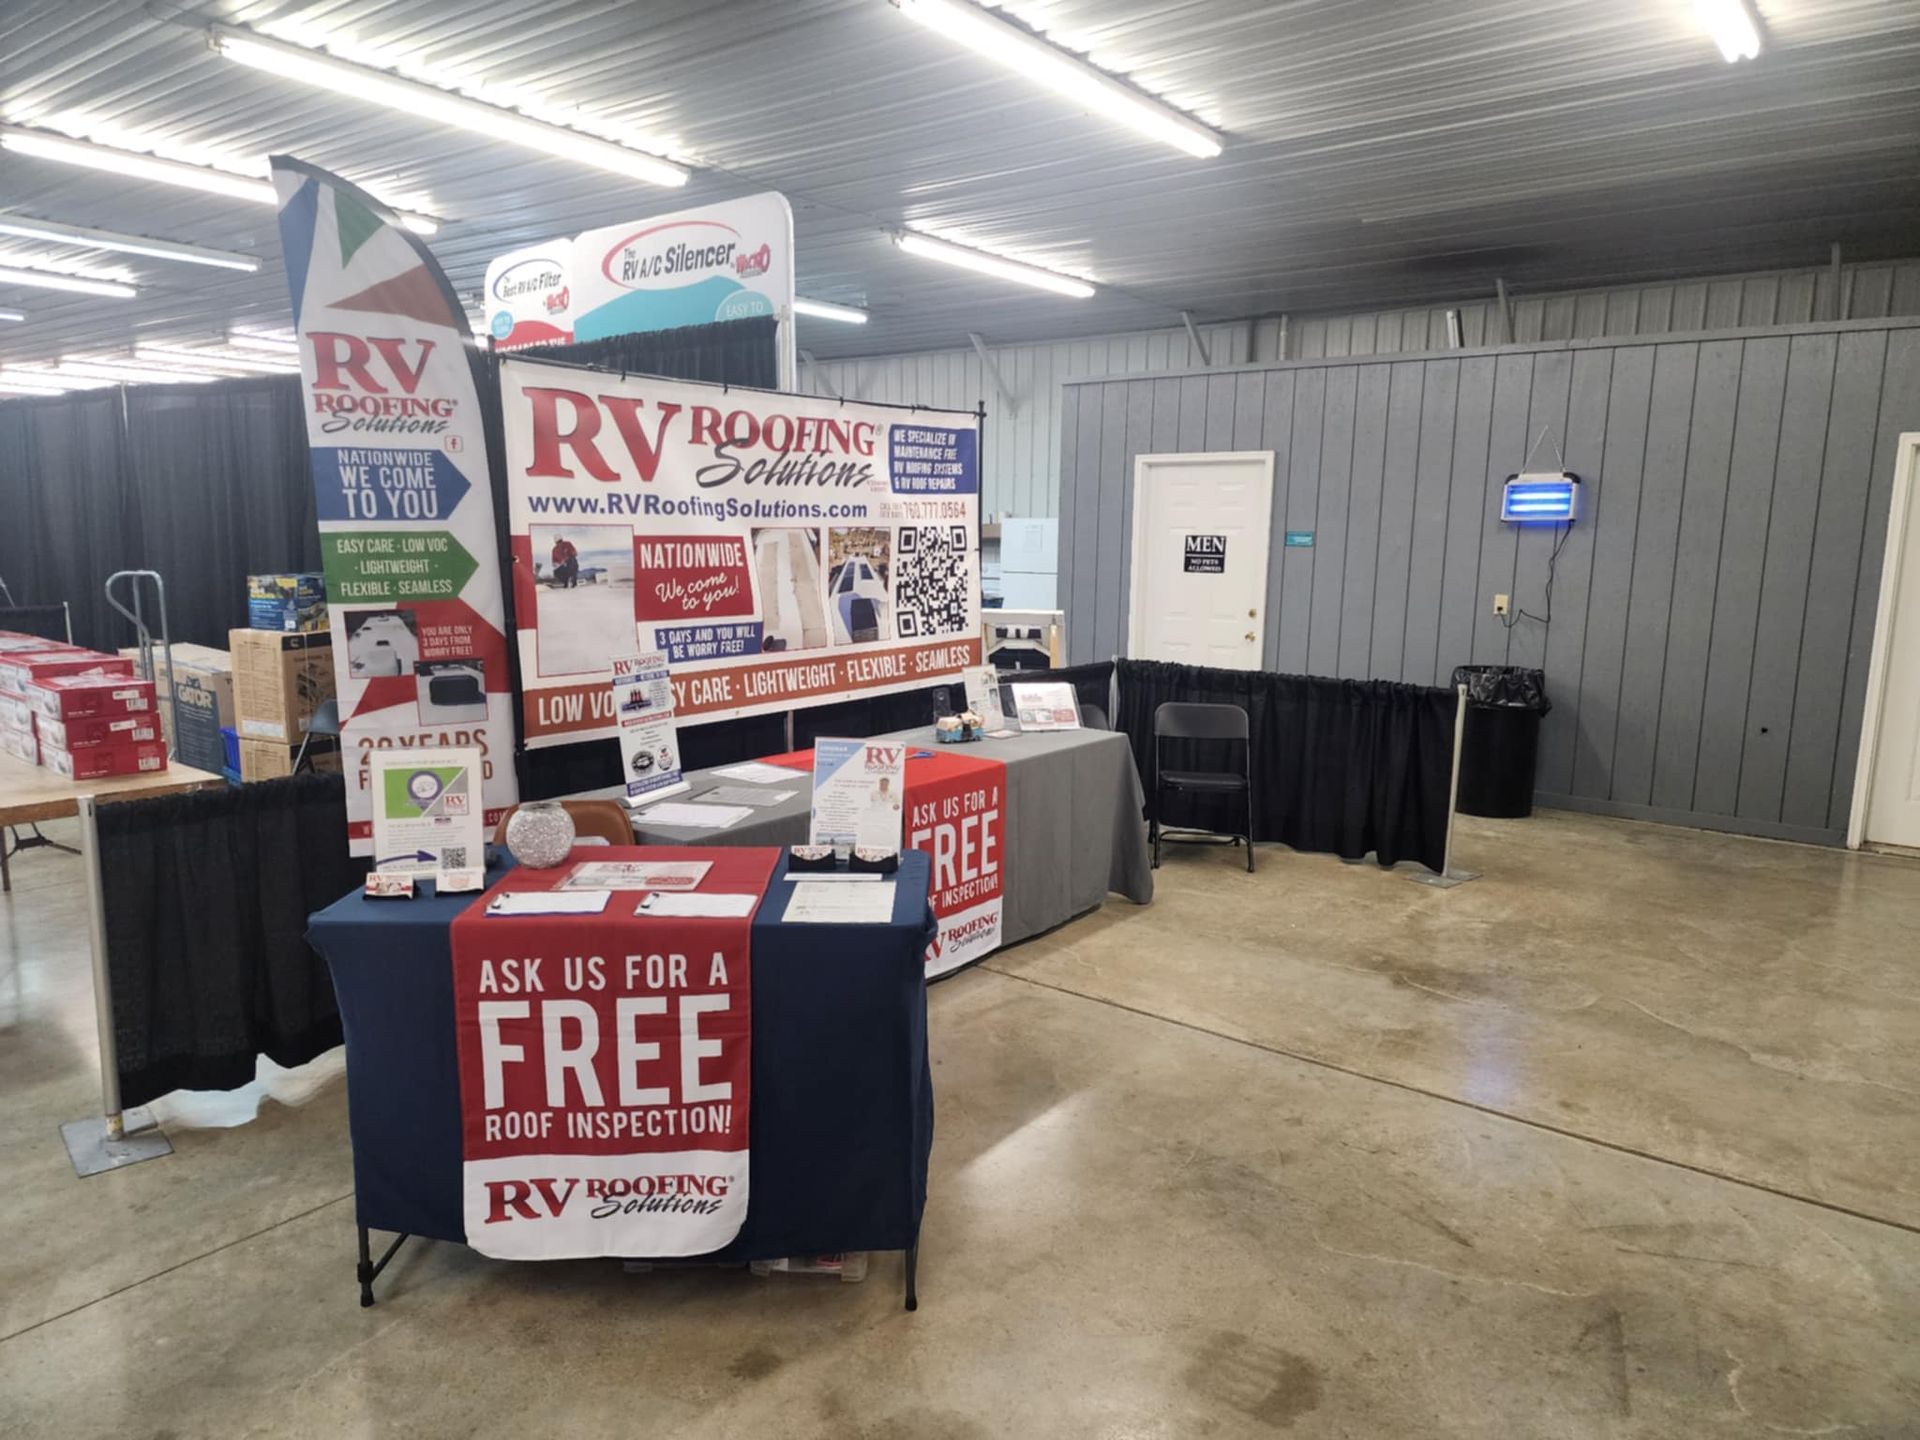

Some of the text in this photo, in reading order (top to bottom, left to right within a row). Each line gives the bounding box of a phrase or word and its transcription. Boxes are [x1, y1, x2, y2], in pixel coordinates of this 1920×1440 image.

[623, 242, 735, 281] RV A/C Silencer
[727, 301, 764, 317] EASY TO
[306, 331, 437, 394] RV
[322, 408, 450, 434] Solutions
[522, 386, 682, 482] RV
[894, 429, 906, 443] WE
[908, 430, 947, 446] SPECIALIZE
[337, 449, 433, 467] NATIONWIDE
[696, 438, 875, 488] Solutions
[894, 445, 943, 460] MAINTENANCE
[339, 467, 436, 489] WE COME
[933, 462, 963, 475] SYSTEMS
[928, 477, 956, 490] REPAIRS
[342, 489, 439, 518] TO YOU
[528, 493, 868, 521] www.RVRoofingSolutions.com
[337, 538, 448, 553] EASY CARE LOW VOC
[640, 542, 744, 569] NATIONWIDE
[1187, 536, 1225, 552] MEN
[360, 559, 430, 575] LIGHTWEIGHT
[340, 580, 390, 597] FLEXIBLE
[399, 579, 453, 594] SEAMLESS
[655, 572, 728, 603] We come
[681, 575, 740, 612] to you!
[421, 625, 473, 637] YOU ARE ONLY
[429, 636, 449, 646] DAYS
[450, 635, 471, 645] FROM
[659, 624, 755, 645] 3 DAYS AND YOU WILL
[424, 647, 450, 657] WORRY
[673, 639, 745, 658] BE WORRY FREE!
[613, 659, 633, 676] RV
[178, 685, 212, 709] GATOR
[538, 694, 584, 726] LOW
[590, 690, 615, 719] VO
[691, 676, 733, 705] CARE
[744, 662, 837, 698] LIGHTWEIGHT
[847, 653, 907, 683] FLEXIBLE
[916, 645, 971, 673] SEAMLESS
[865, 746, 903, 764] RV
[445, 795, 465, 805] RV
[912, 786, 998, 828] ASK US FOR A
[942, 875, 998, 909] INSPECTION!
[924, 912, 997, 961] V ROOFING
[479, 951, 728, 994] ASK US FOR A
[478, 993, 732, 1110] FREE
[485, 1105, 732, 1142] ROOF INSPECTION!
[484, 1178, 580, 1224] RV
[591, 1191, 723, 1219] Solutions
